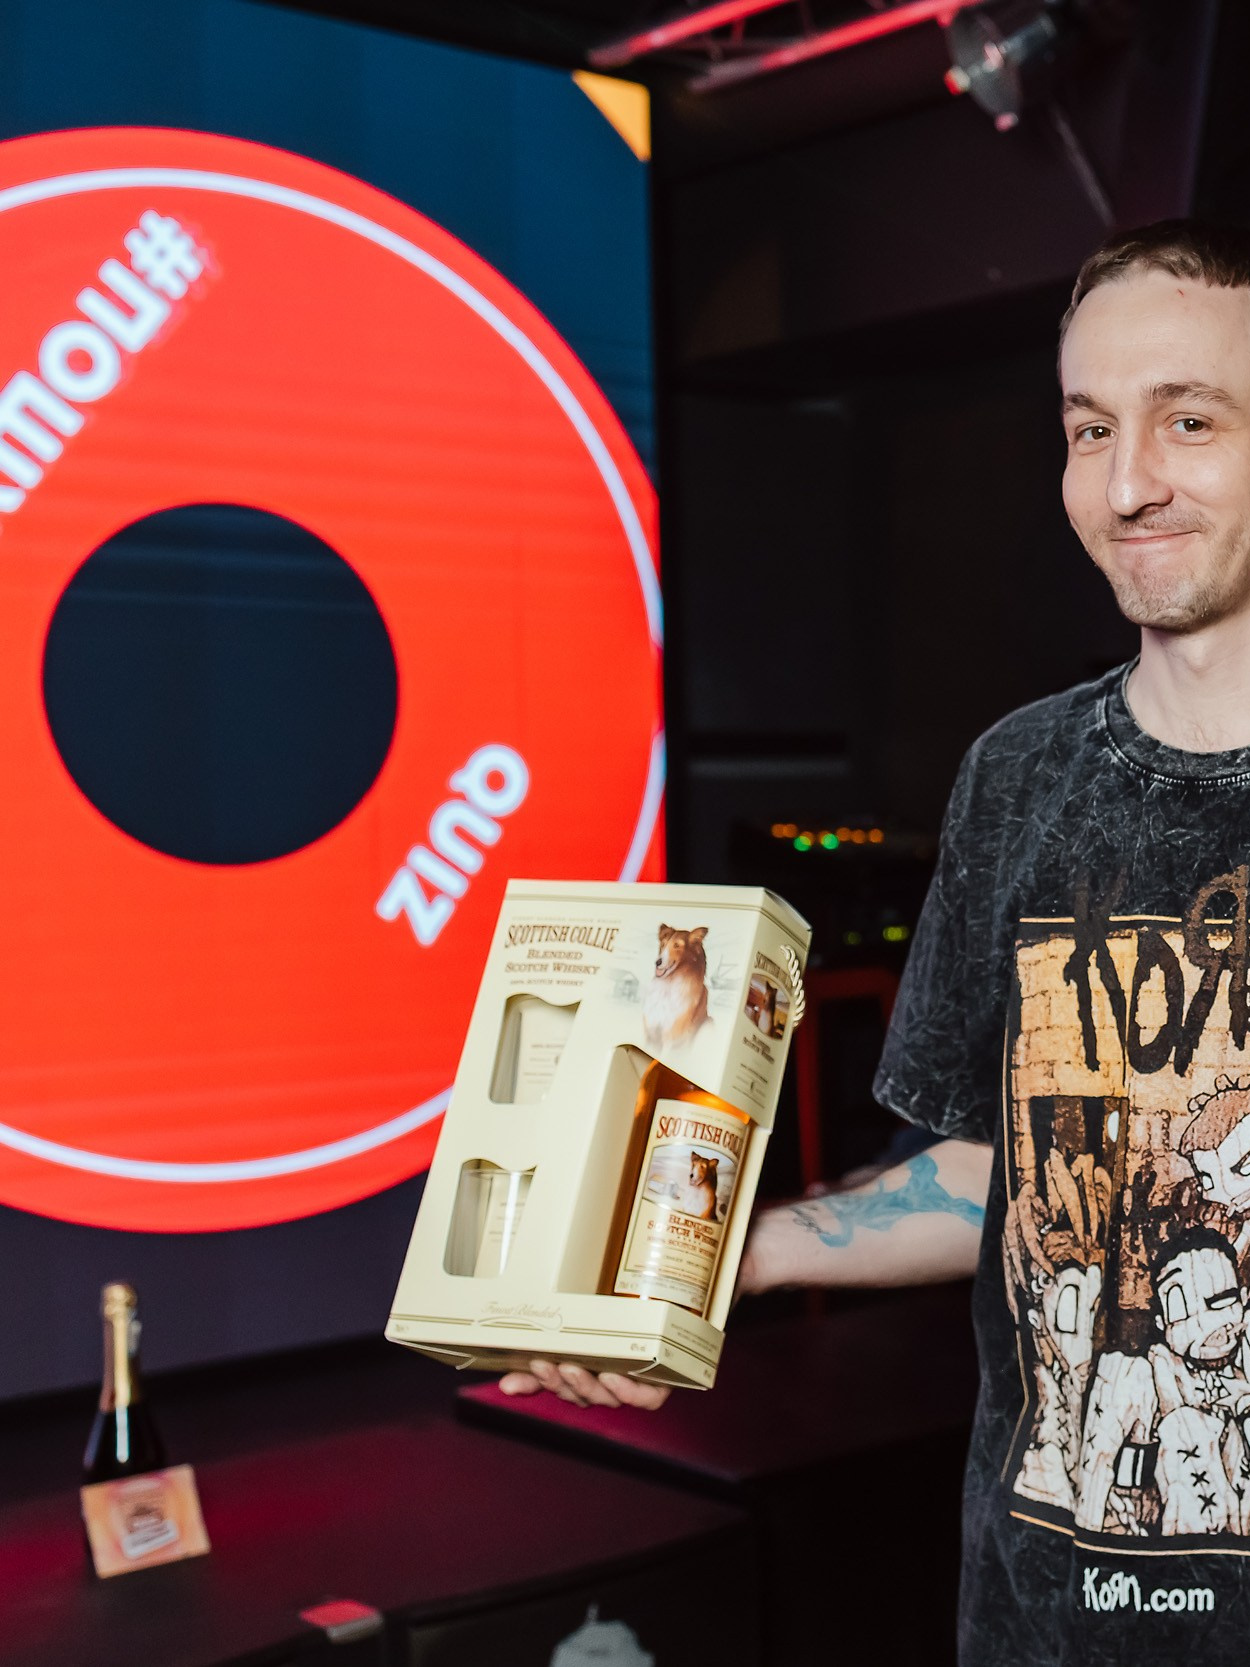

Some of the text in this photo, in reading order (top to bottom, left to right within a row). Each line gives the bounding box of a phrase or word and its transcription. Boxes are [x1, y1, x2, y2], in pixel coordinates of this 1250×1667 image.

[374, 743, 530, 947] QUIZ
[505, 924, 619, 952] SCOTTISH COLLIE
[656, 1115, 722, 1145] SCOTTISH
